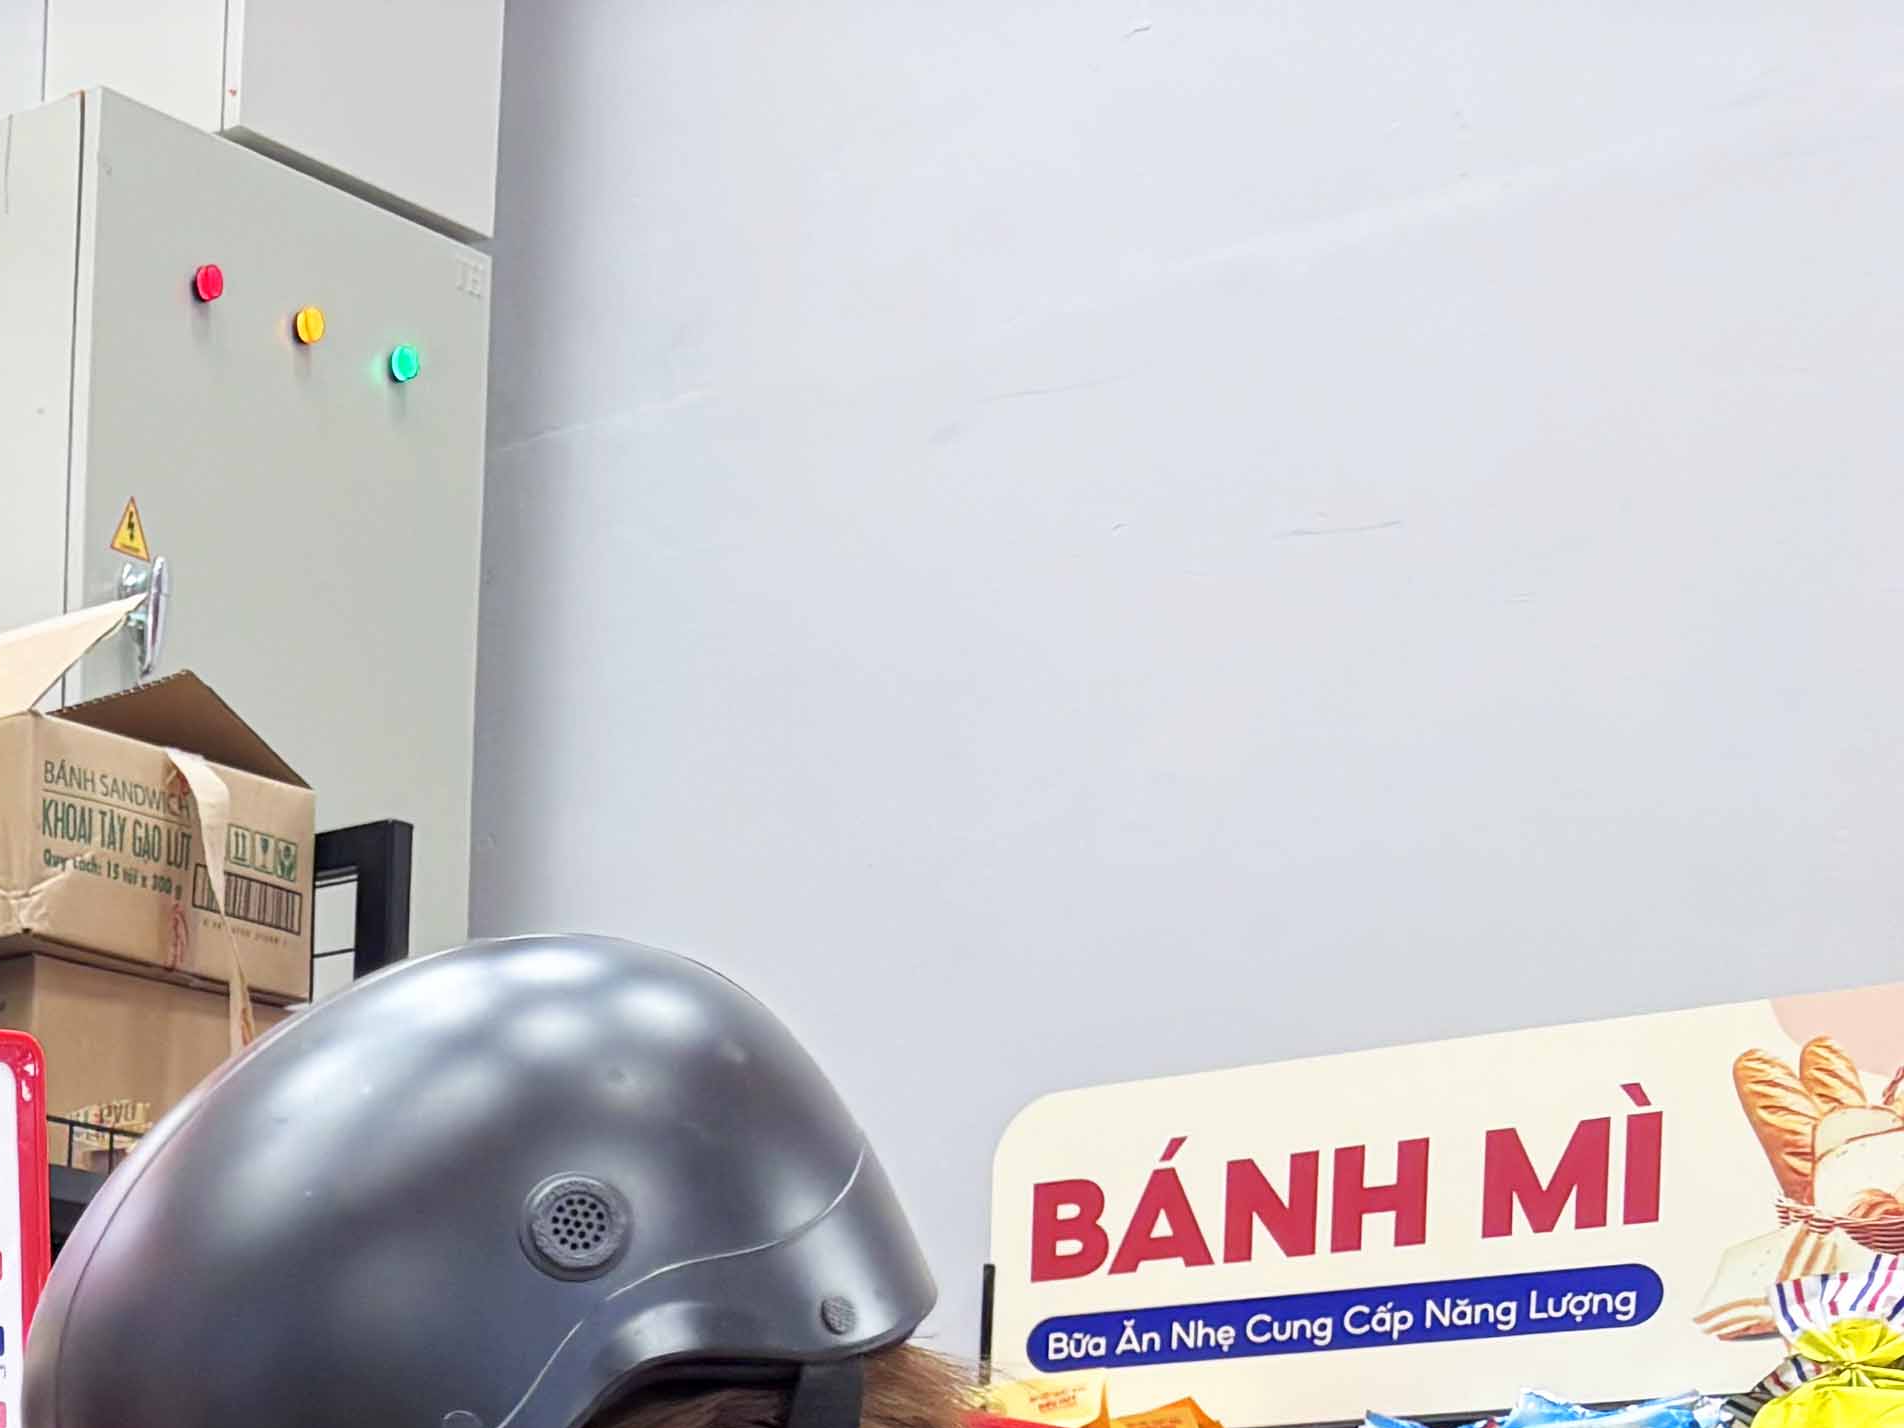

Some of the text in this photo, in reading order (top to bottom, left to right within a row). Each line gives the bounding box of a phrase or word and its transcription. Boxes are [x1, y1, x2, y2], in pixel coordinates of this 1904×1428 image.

[1030, 1082, 1663, 1284] BÁNH MÌ
[1047, 1284, 1637, 1360] Bữa Ăn Nhẹ Cung Cấp Năng Lượng
